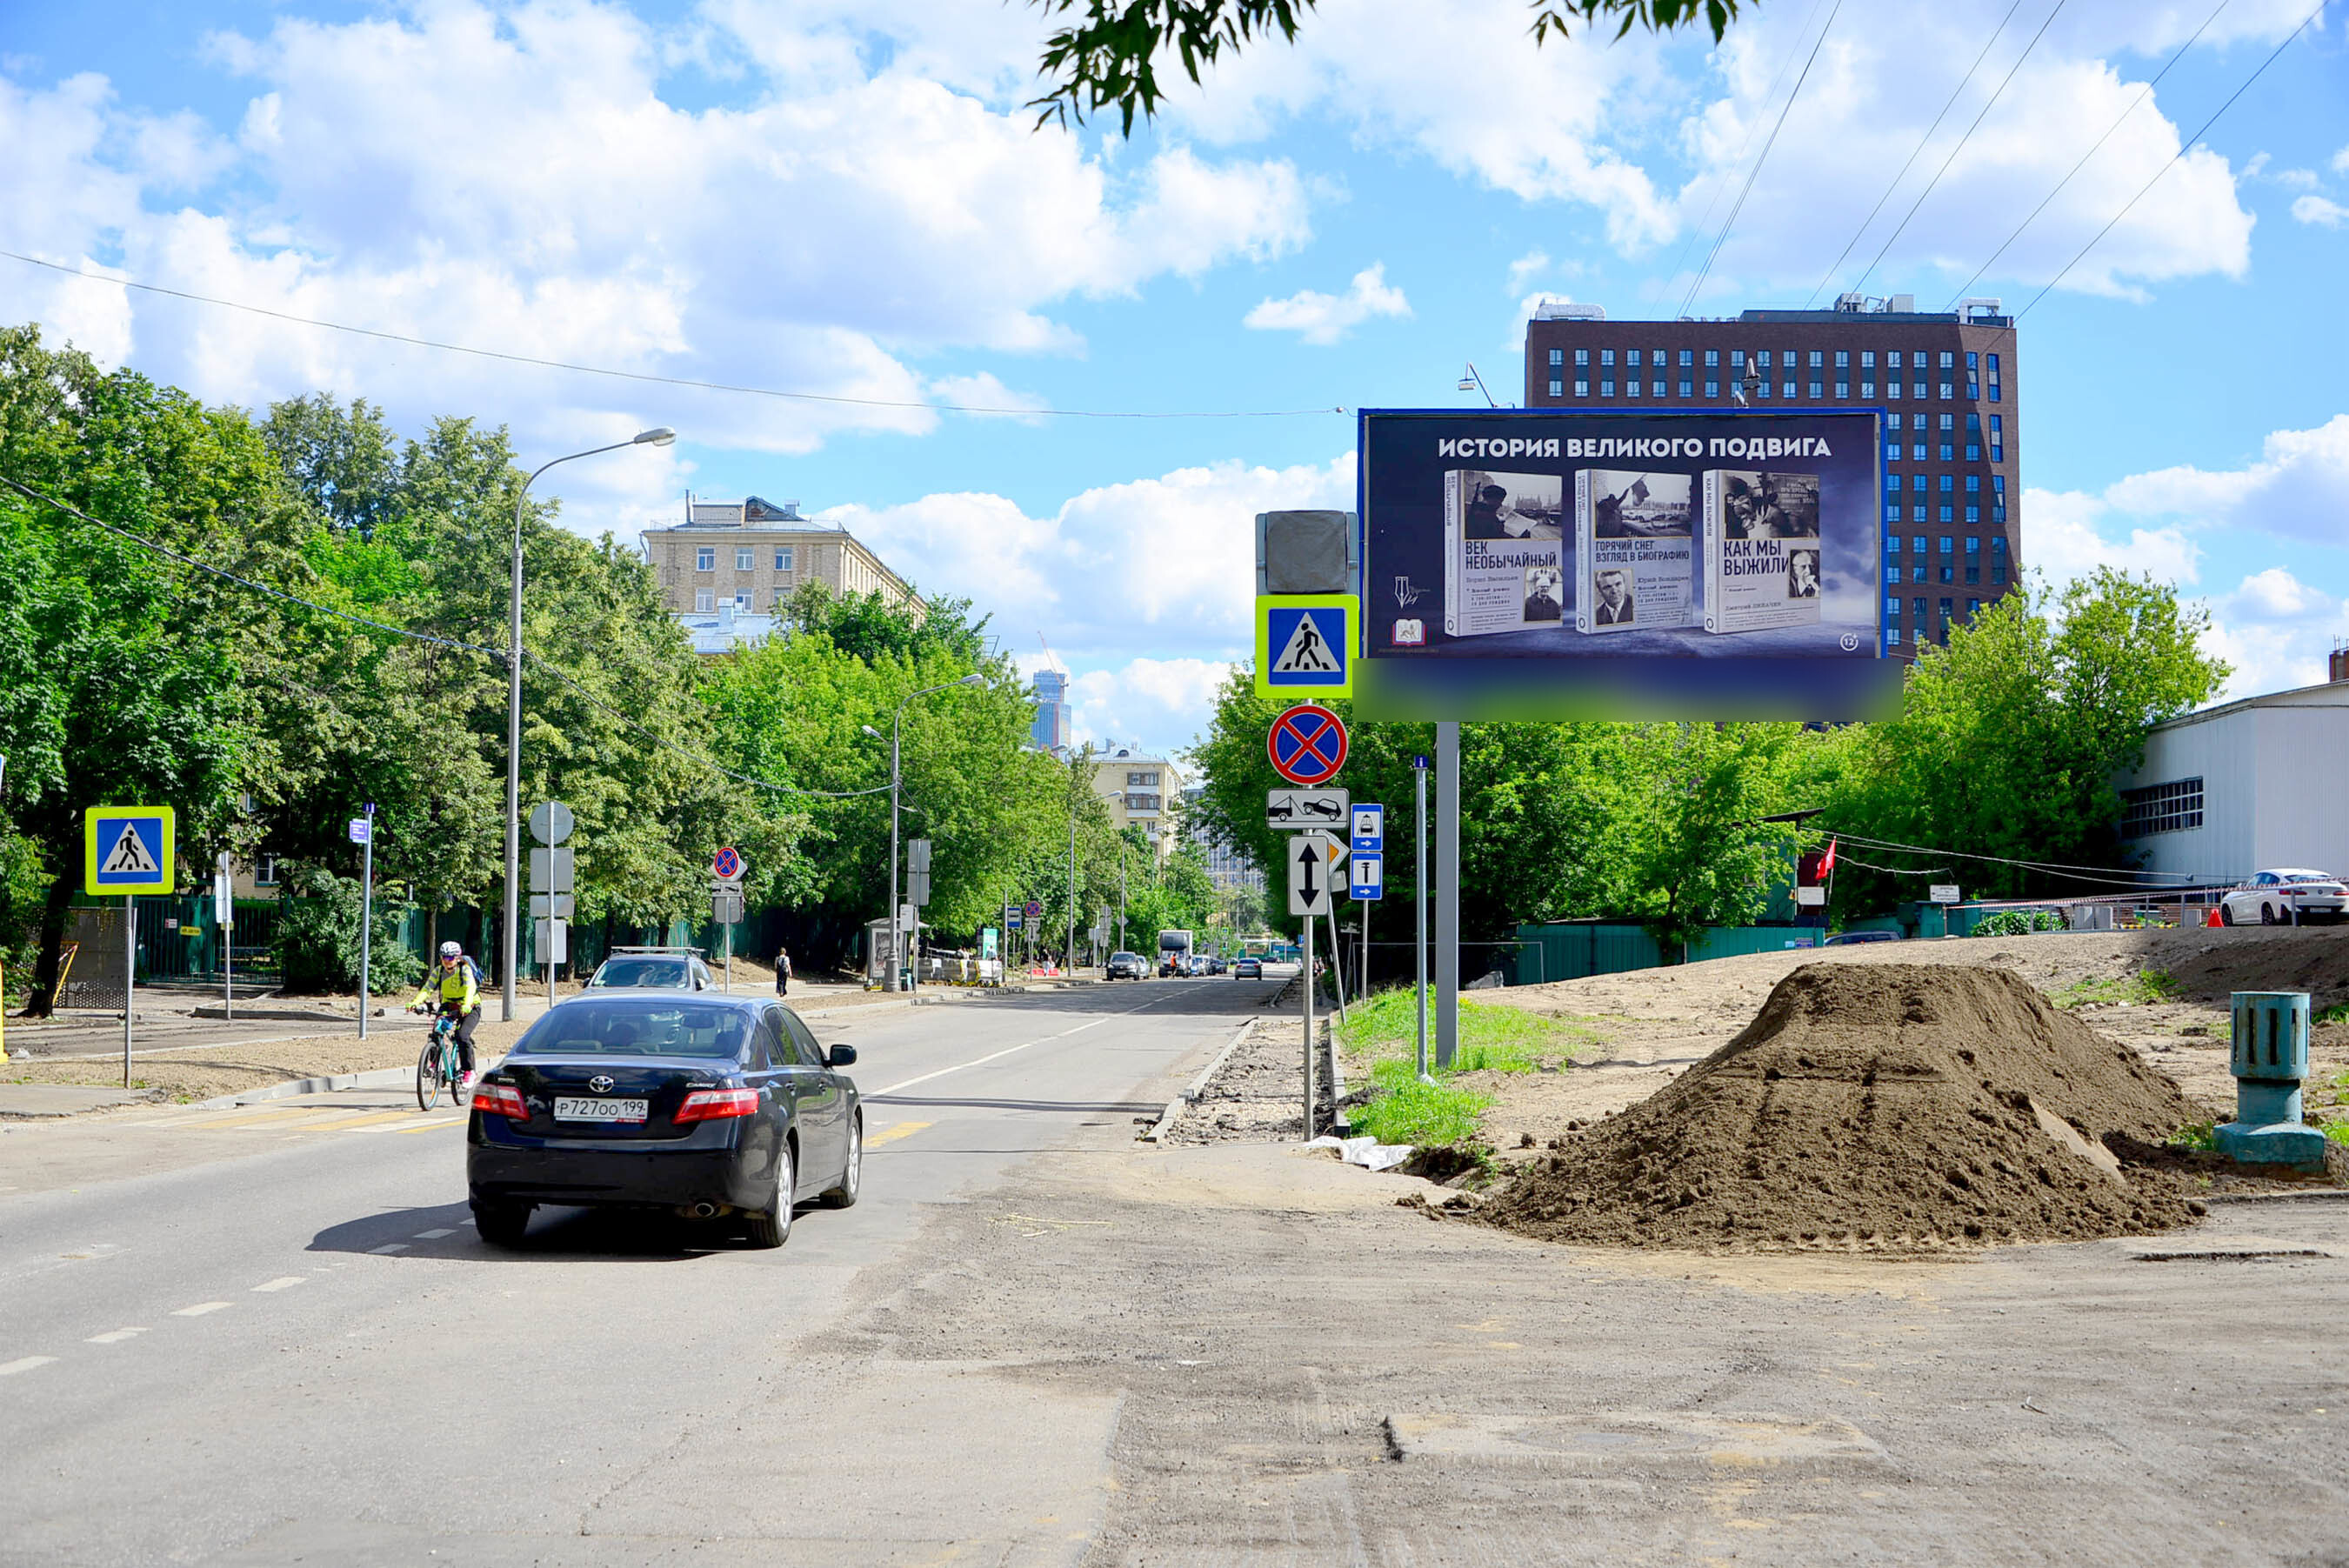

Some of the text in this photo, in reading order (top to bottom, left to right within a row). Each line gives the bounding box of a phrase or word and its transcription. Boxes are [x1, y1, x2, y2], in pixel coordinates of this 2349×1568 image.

[1438, 437, 1832, 461] ИСТОРИЯ ВЕЛИКОГО ПОДВИГА
[1465, 541, 1488, 555] ВЕК
[1596, 539, 1654, 551] ГОРЯЧИЙ СНЕГ
[1724, 541, 1752, 557] КАК
[1757, 540, 1781, 556] МЫ
[1465, 551, 1557, 570] НЕОБЫЧАЙНЫЙ
[1596, 550, 1690, 563] ВЗГЛЯД В БИОГРАФИЮ
[1724, 557, 1789, 576] ВЫЖИЛИ
[623, 1100, 644, 1113] 199
